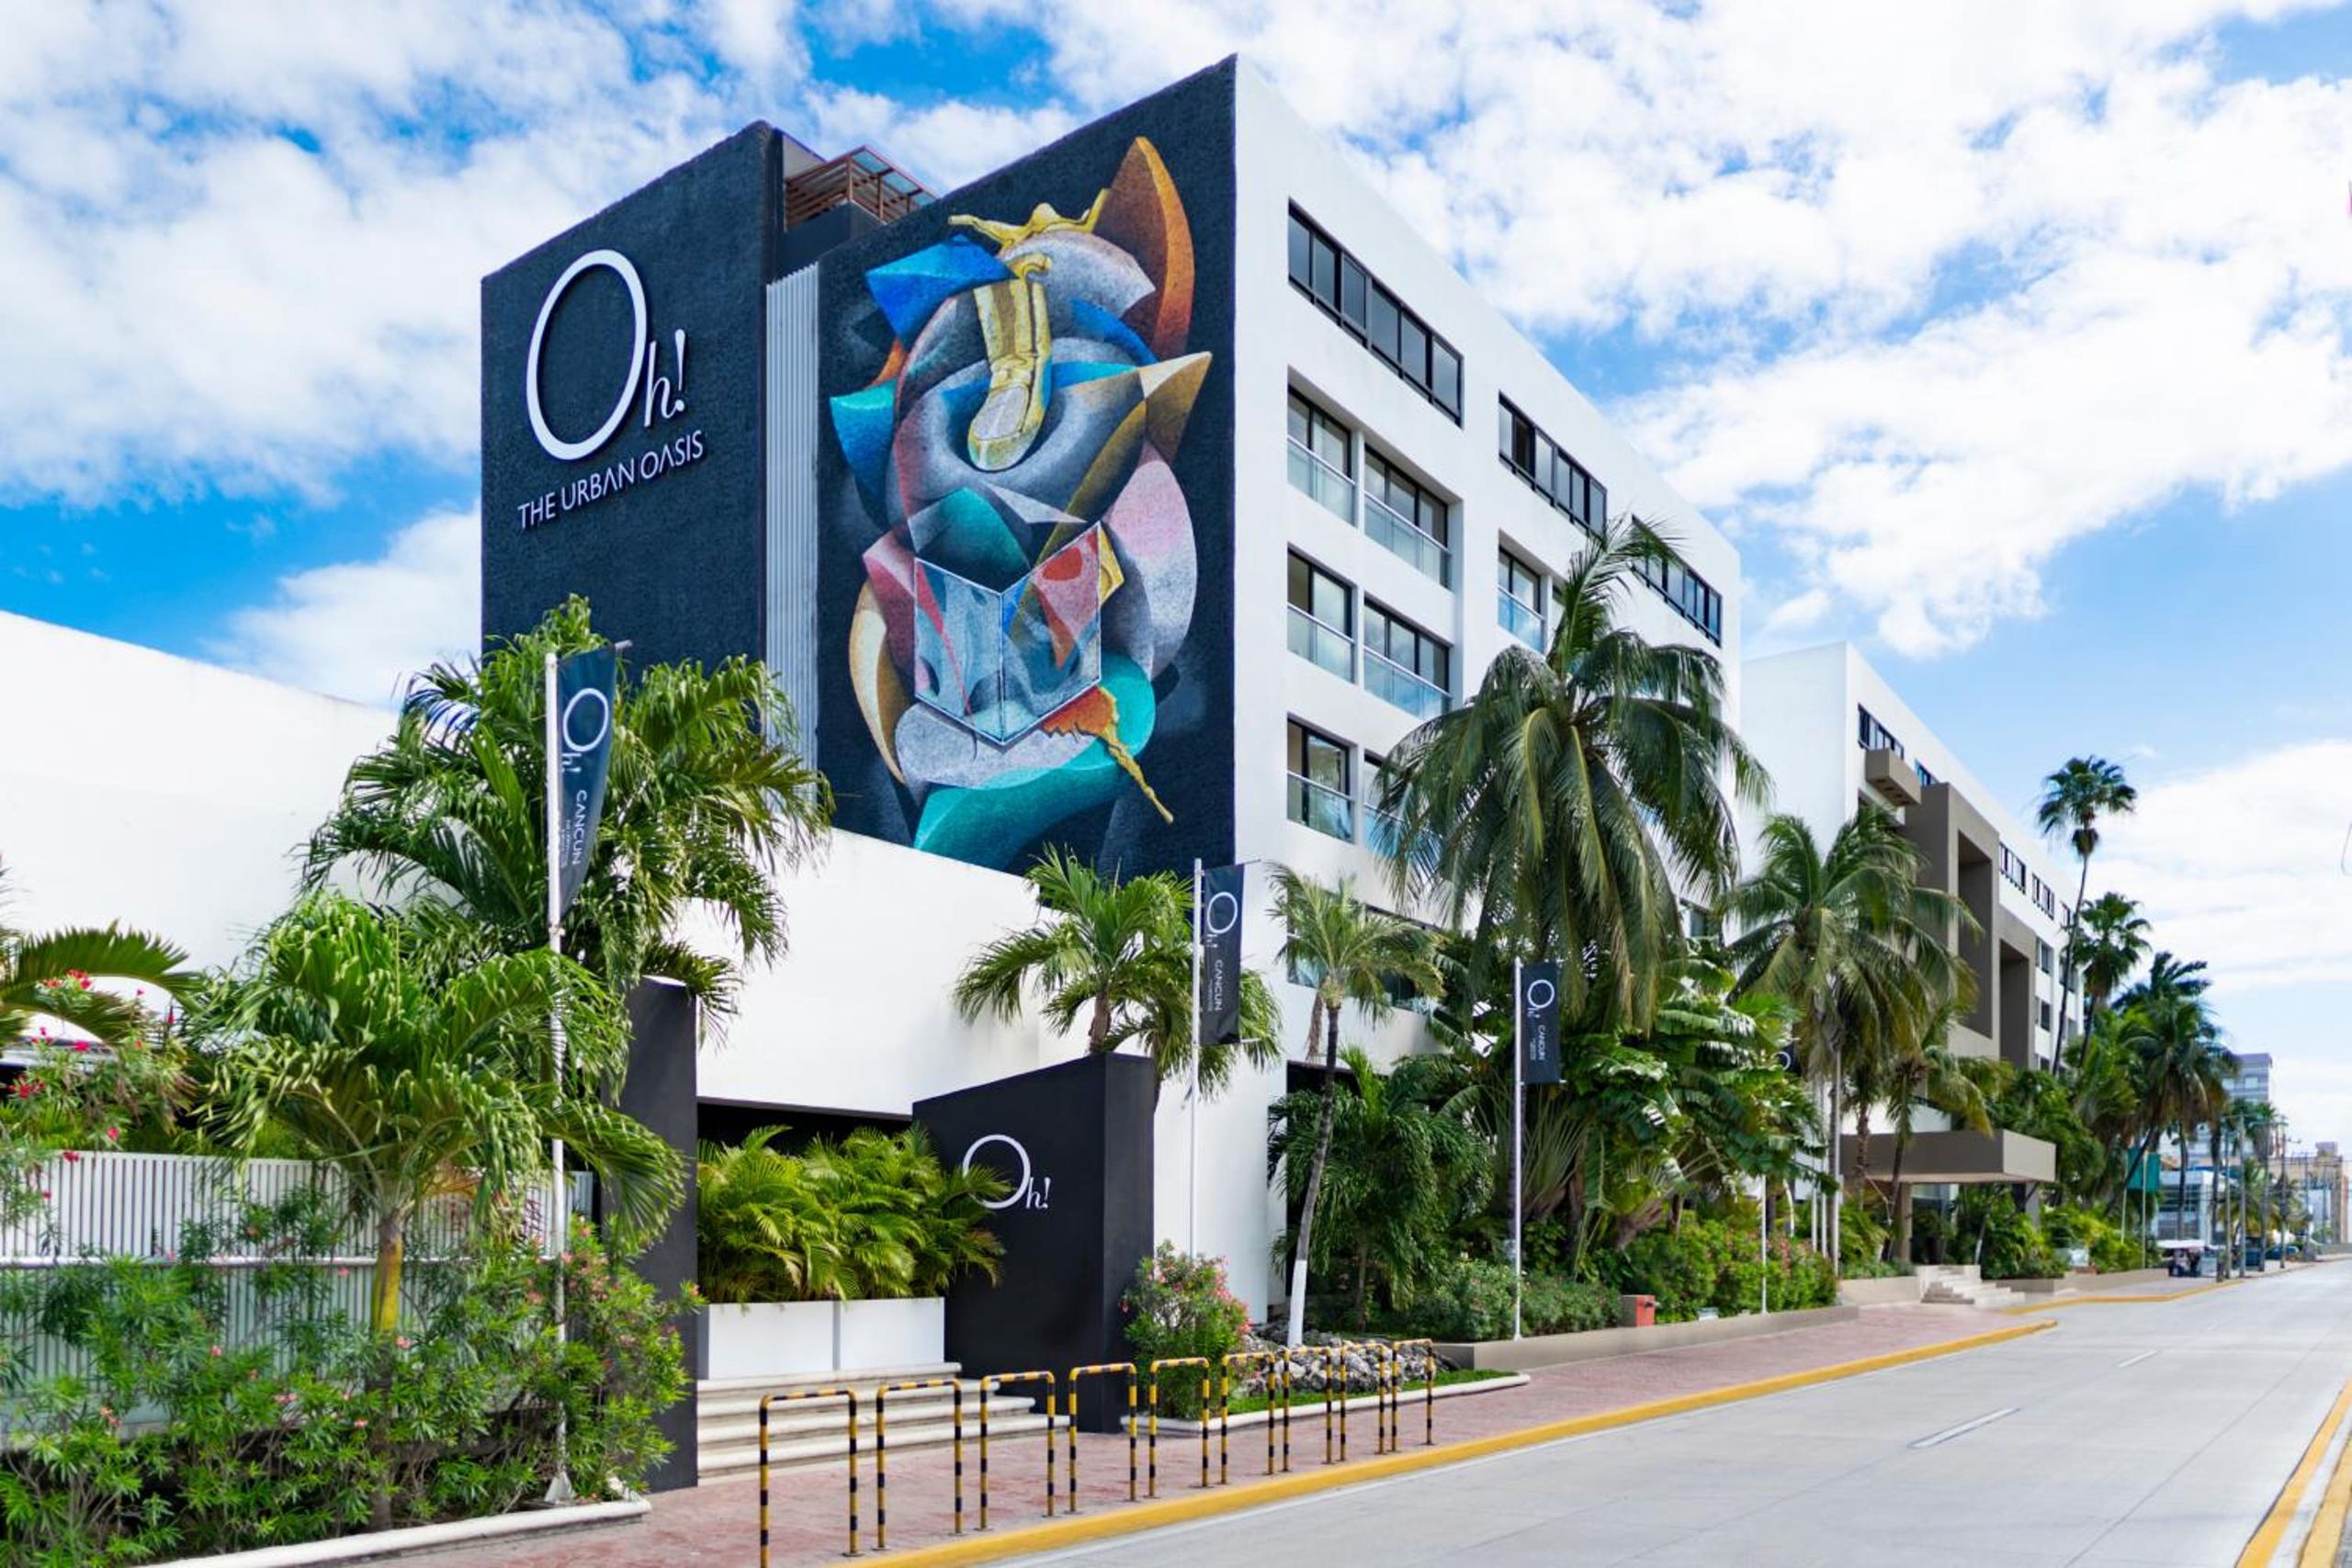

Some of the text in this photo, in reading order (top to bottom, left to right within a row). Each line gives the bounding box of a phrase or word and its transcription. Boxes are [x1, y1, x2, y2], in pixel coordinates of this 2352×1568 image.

[526, 249, 685, 460] Oh!
[517, 430, 704, 529] THE URBAN OASIS
[562, 688, 609, 774] Oh!
[572, 789, 587, 865] CANCUN
[1215, 960, 1224, 1011] CANCUN
[963, 1134, 1051, 1209] Oh!
